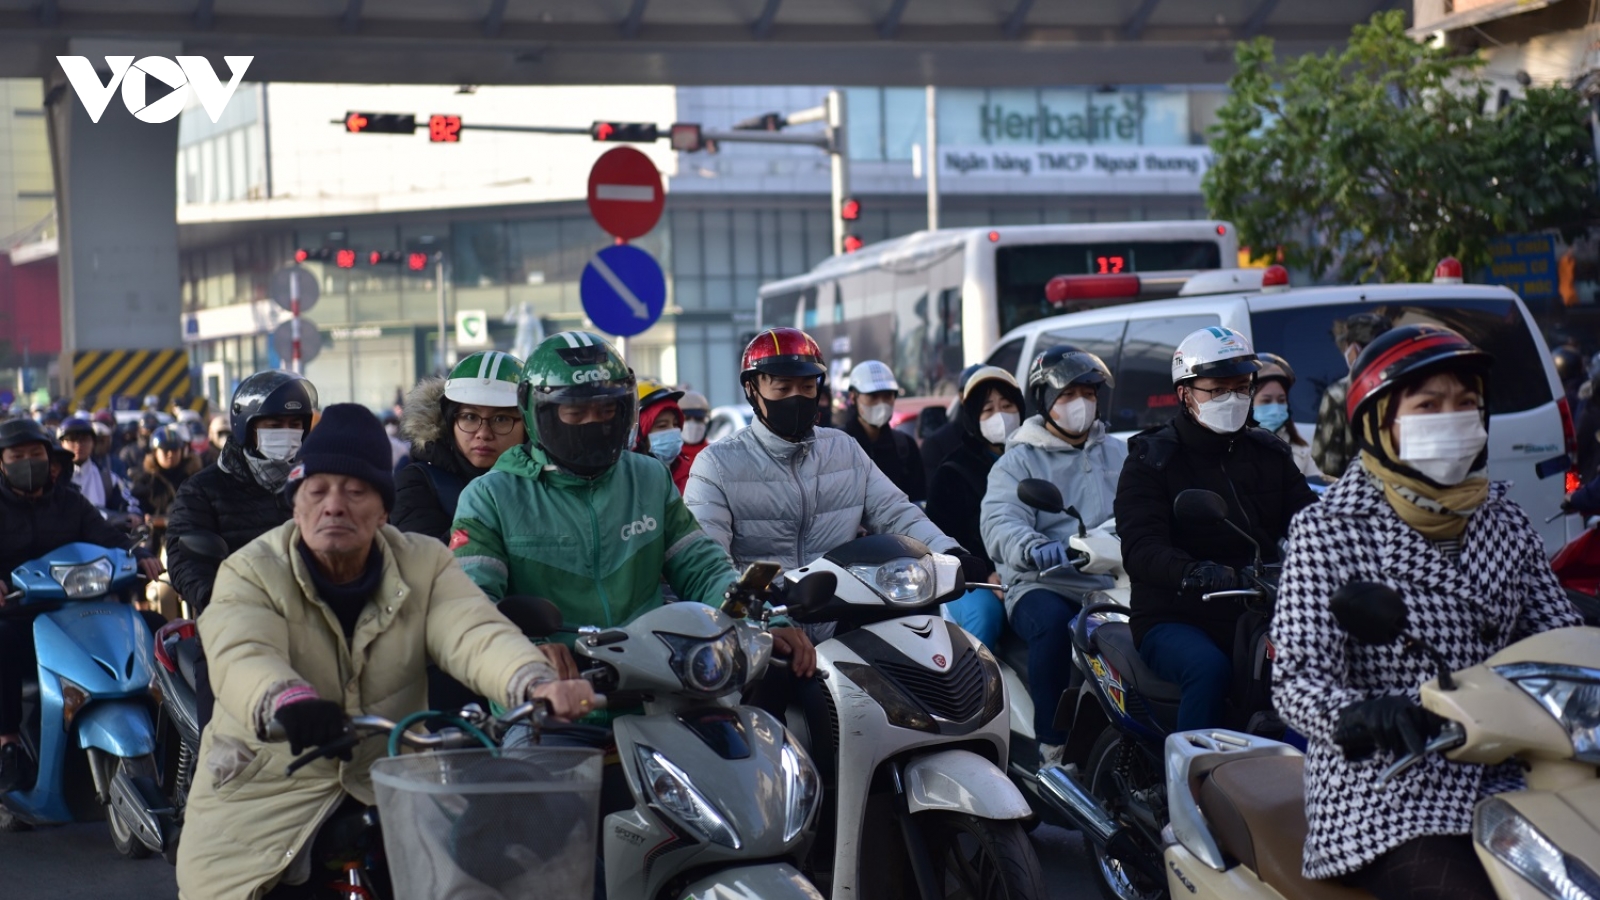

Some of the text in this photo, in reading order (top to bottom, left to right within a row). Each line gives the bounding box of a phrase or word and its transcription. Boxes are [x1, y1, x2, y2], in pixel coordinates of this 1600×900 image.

[430, 115, 460, 142] 82
[980, 103, 1136, 139] Herbalife
[1037, 152, 1088, 171] TMCP
[572, 365, 611, 384] Grab
[621, 515, 657, 541] Grab
